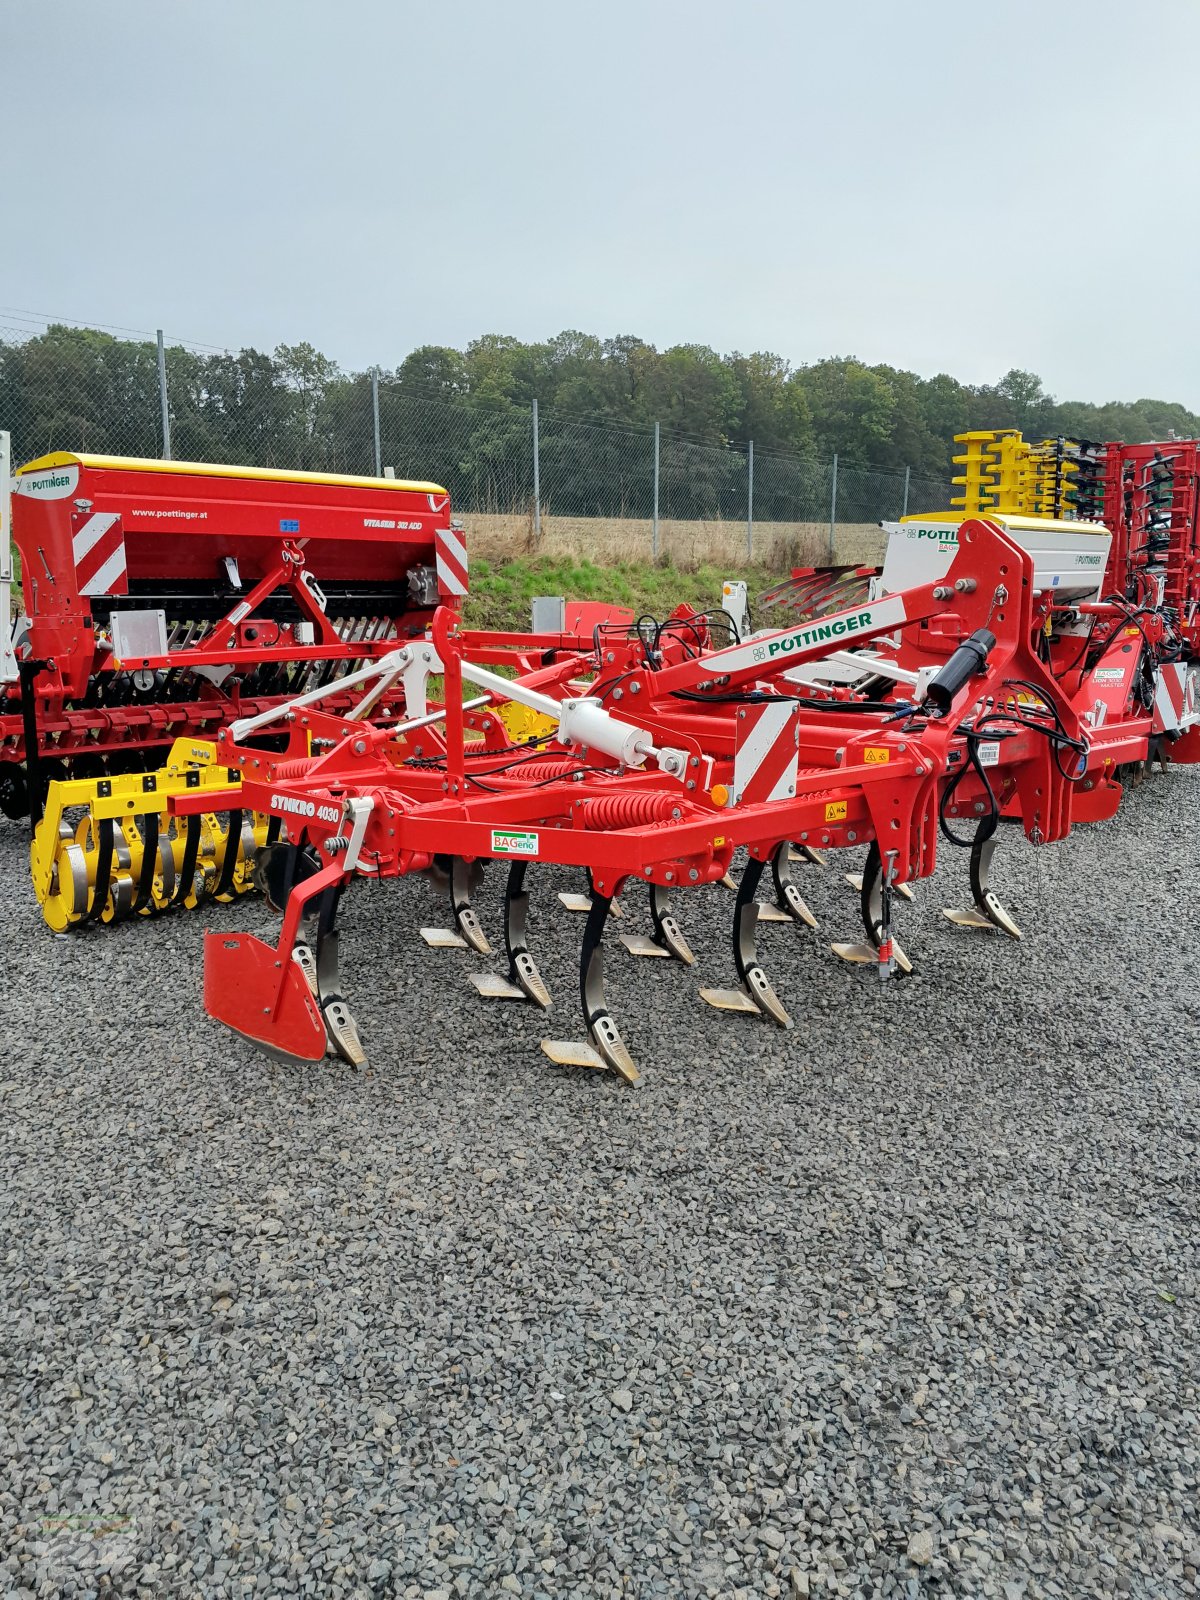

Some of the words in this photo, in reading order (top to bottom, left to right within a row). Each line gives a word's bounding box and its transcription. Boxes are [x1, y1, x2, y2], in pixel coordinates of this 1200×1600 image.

[132, 509, 208, 519] www.poettinger.at
[408, 522, 422, 530] ADD
[270, 794, 315, 817] SYNKRO
[316, 805, 339, 823] 4030
[494, 836, 534, 850] BAGeno
